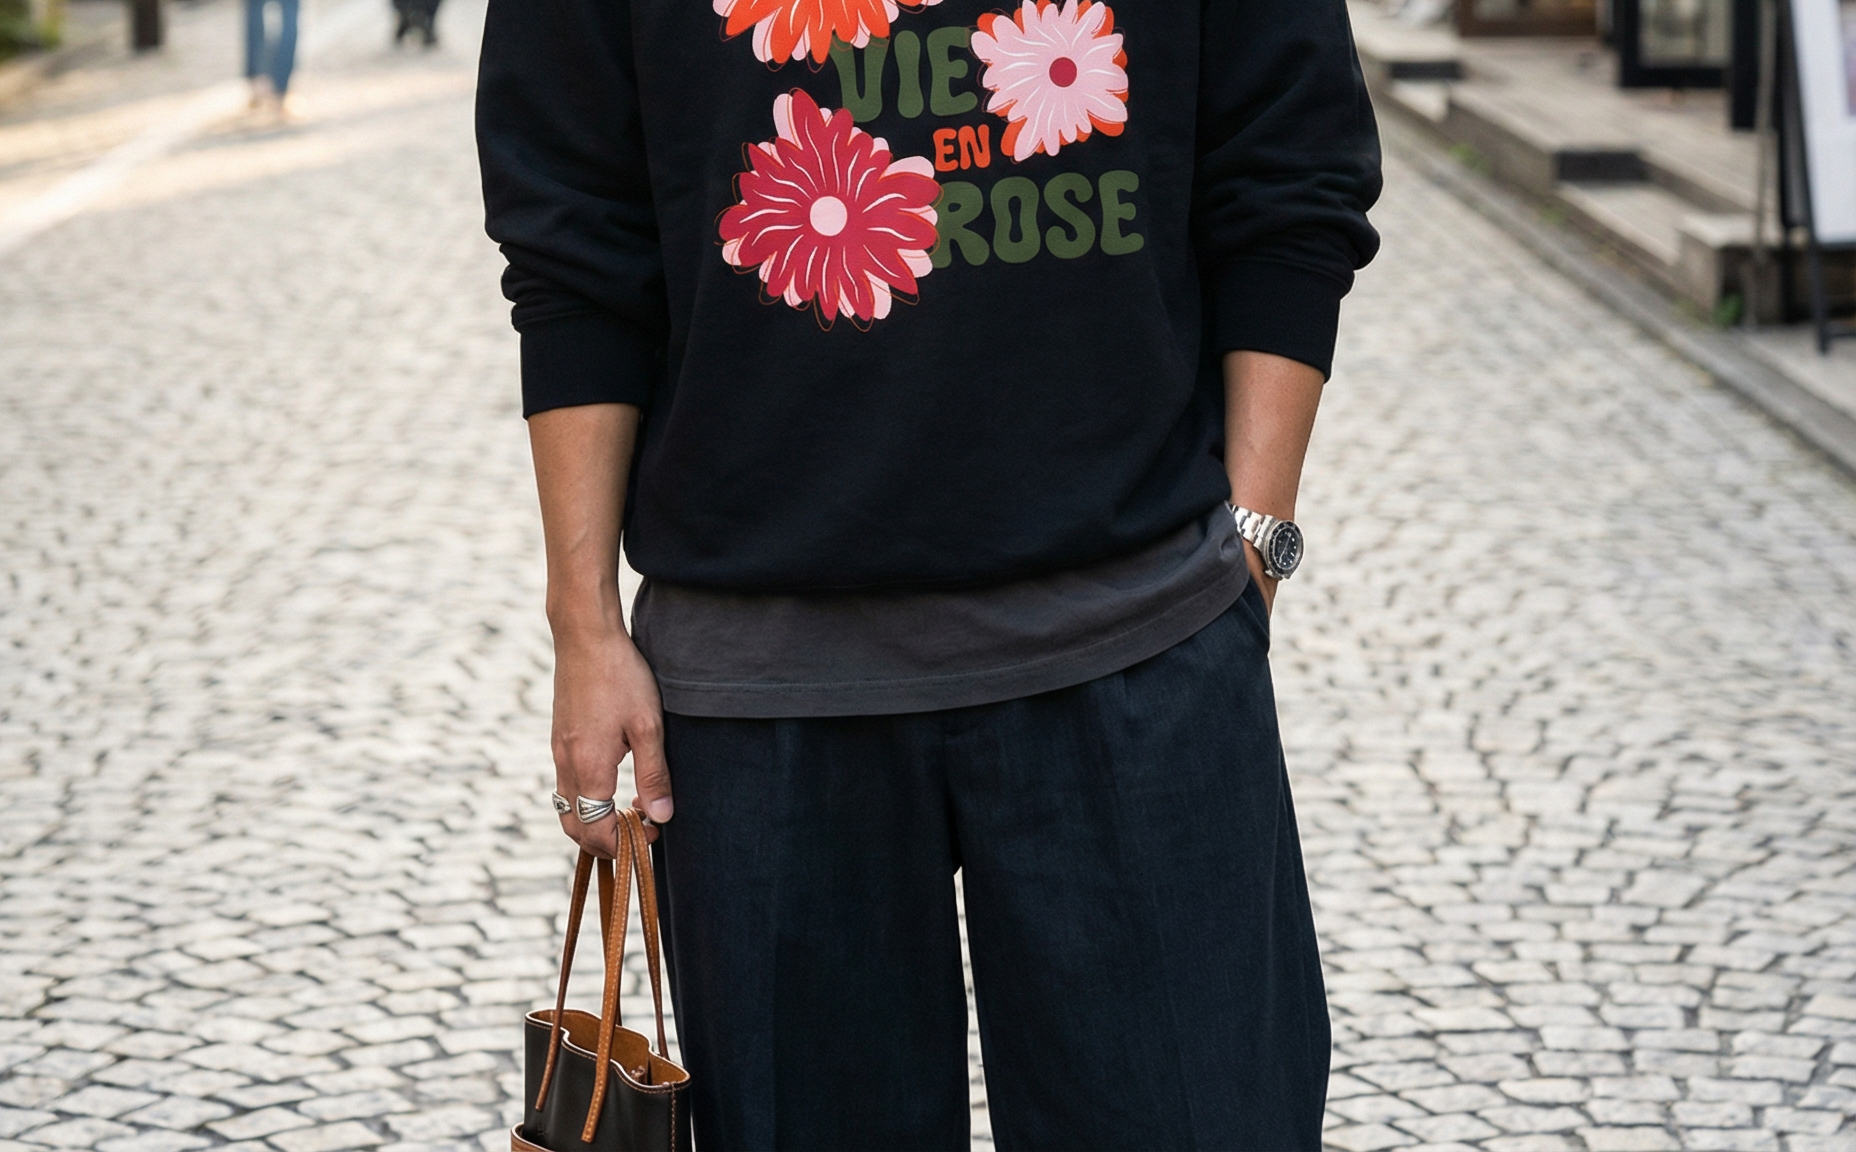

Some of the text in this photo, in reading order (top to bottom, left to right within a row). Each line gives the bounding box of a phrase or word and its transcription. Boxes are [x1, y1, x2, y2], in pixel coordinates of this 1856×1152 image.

[830, 27, 978, 123] VIE
[932, 125, 991, 171] EN
[933, 170, 1144, 268] ROSE
